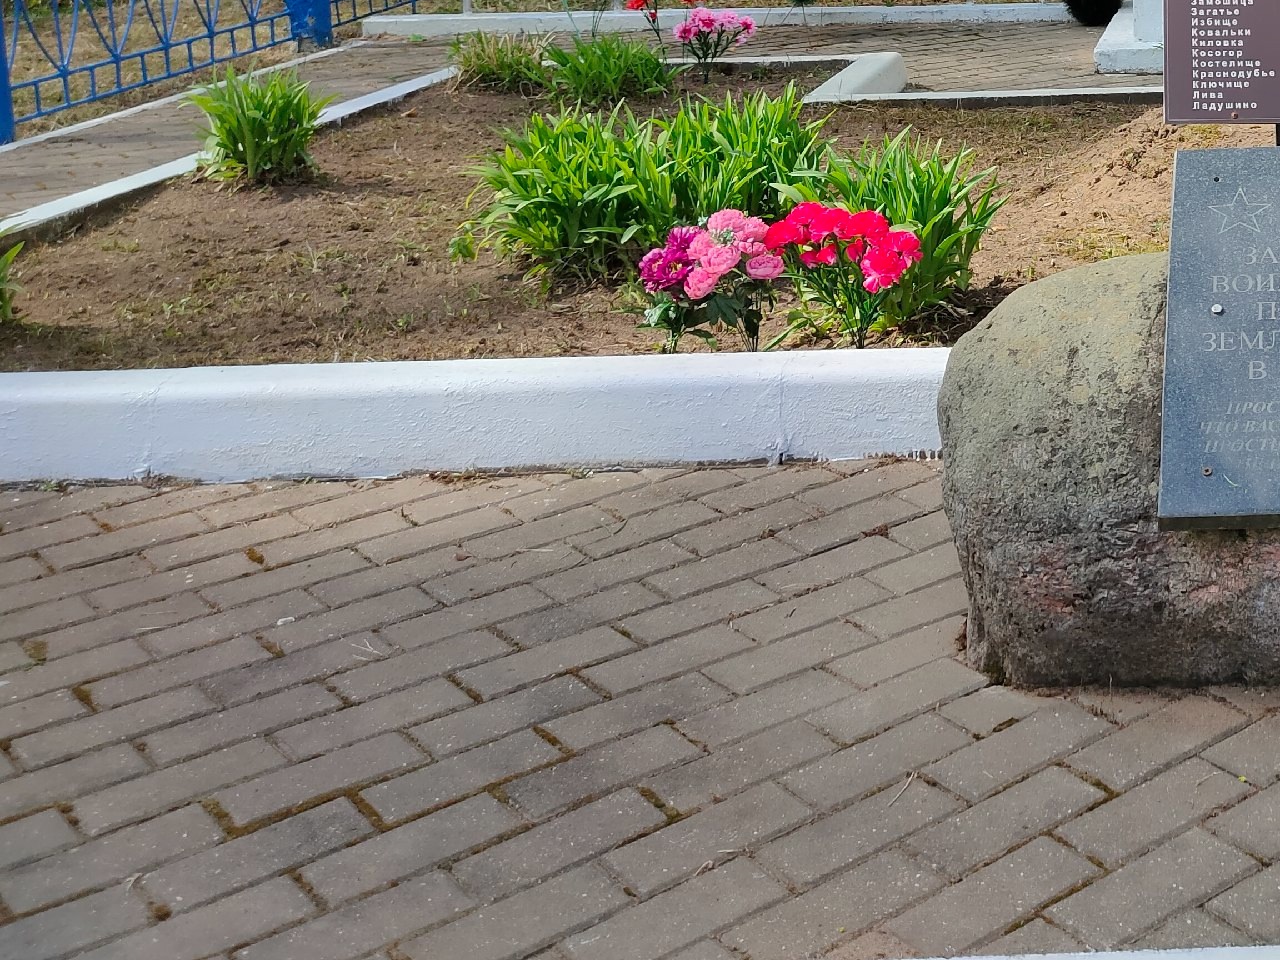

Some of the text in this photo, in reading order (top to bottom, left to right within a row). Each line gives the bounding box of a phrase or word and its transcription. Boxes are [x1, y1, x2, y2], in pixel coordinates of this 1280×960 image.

[1191, 8, 1239, 16] Загатье
[1192, 18, 1237, 27] Избище
[1192, 28, 1251, 37] Ковальки
[1192, 38, 1243, 46] Киловка
[1192, 49, 1242, 58] Косогор
[1193, 59, 1260, 67] Костелище
[1193, 69, 1275, 79] Краснодубье
[1193, 91, 1223, 99] Лива
[1193, 102, 1257, 111] Ладушино
[1248, 360, 1267, 381] В
